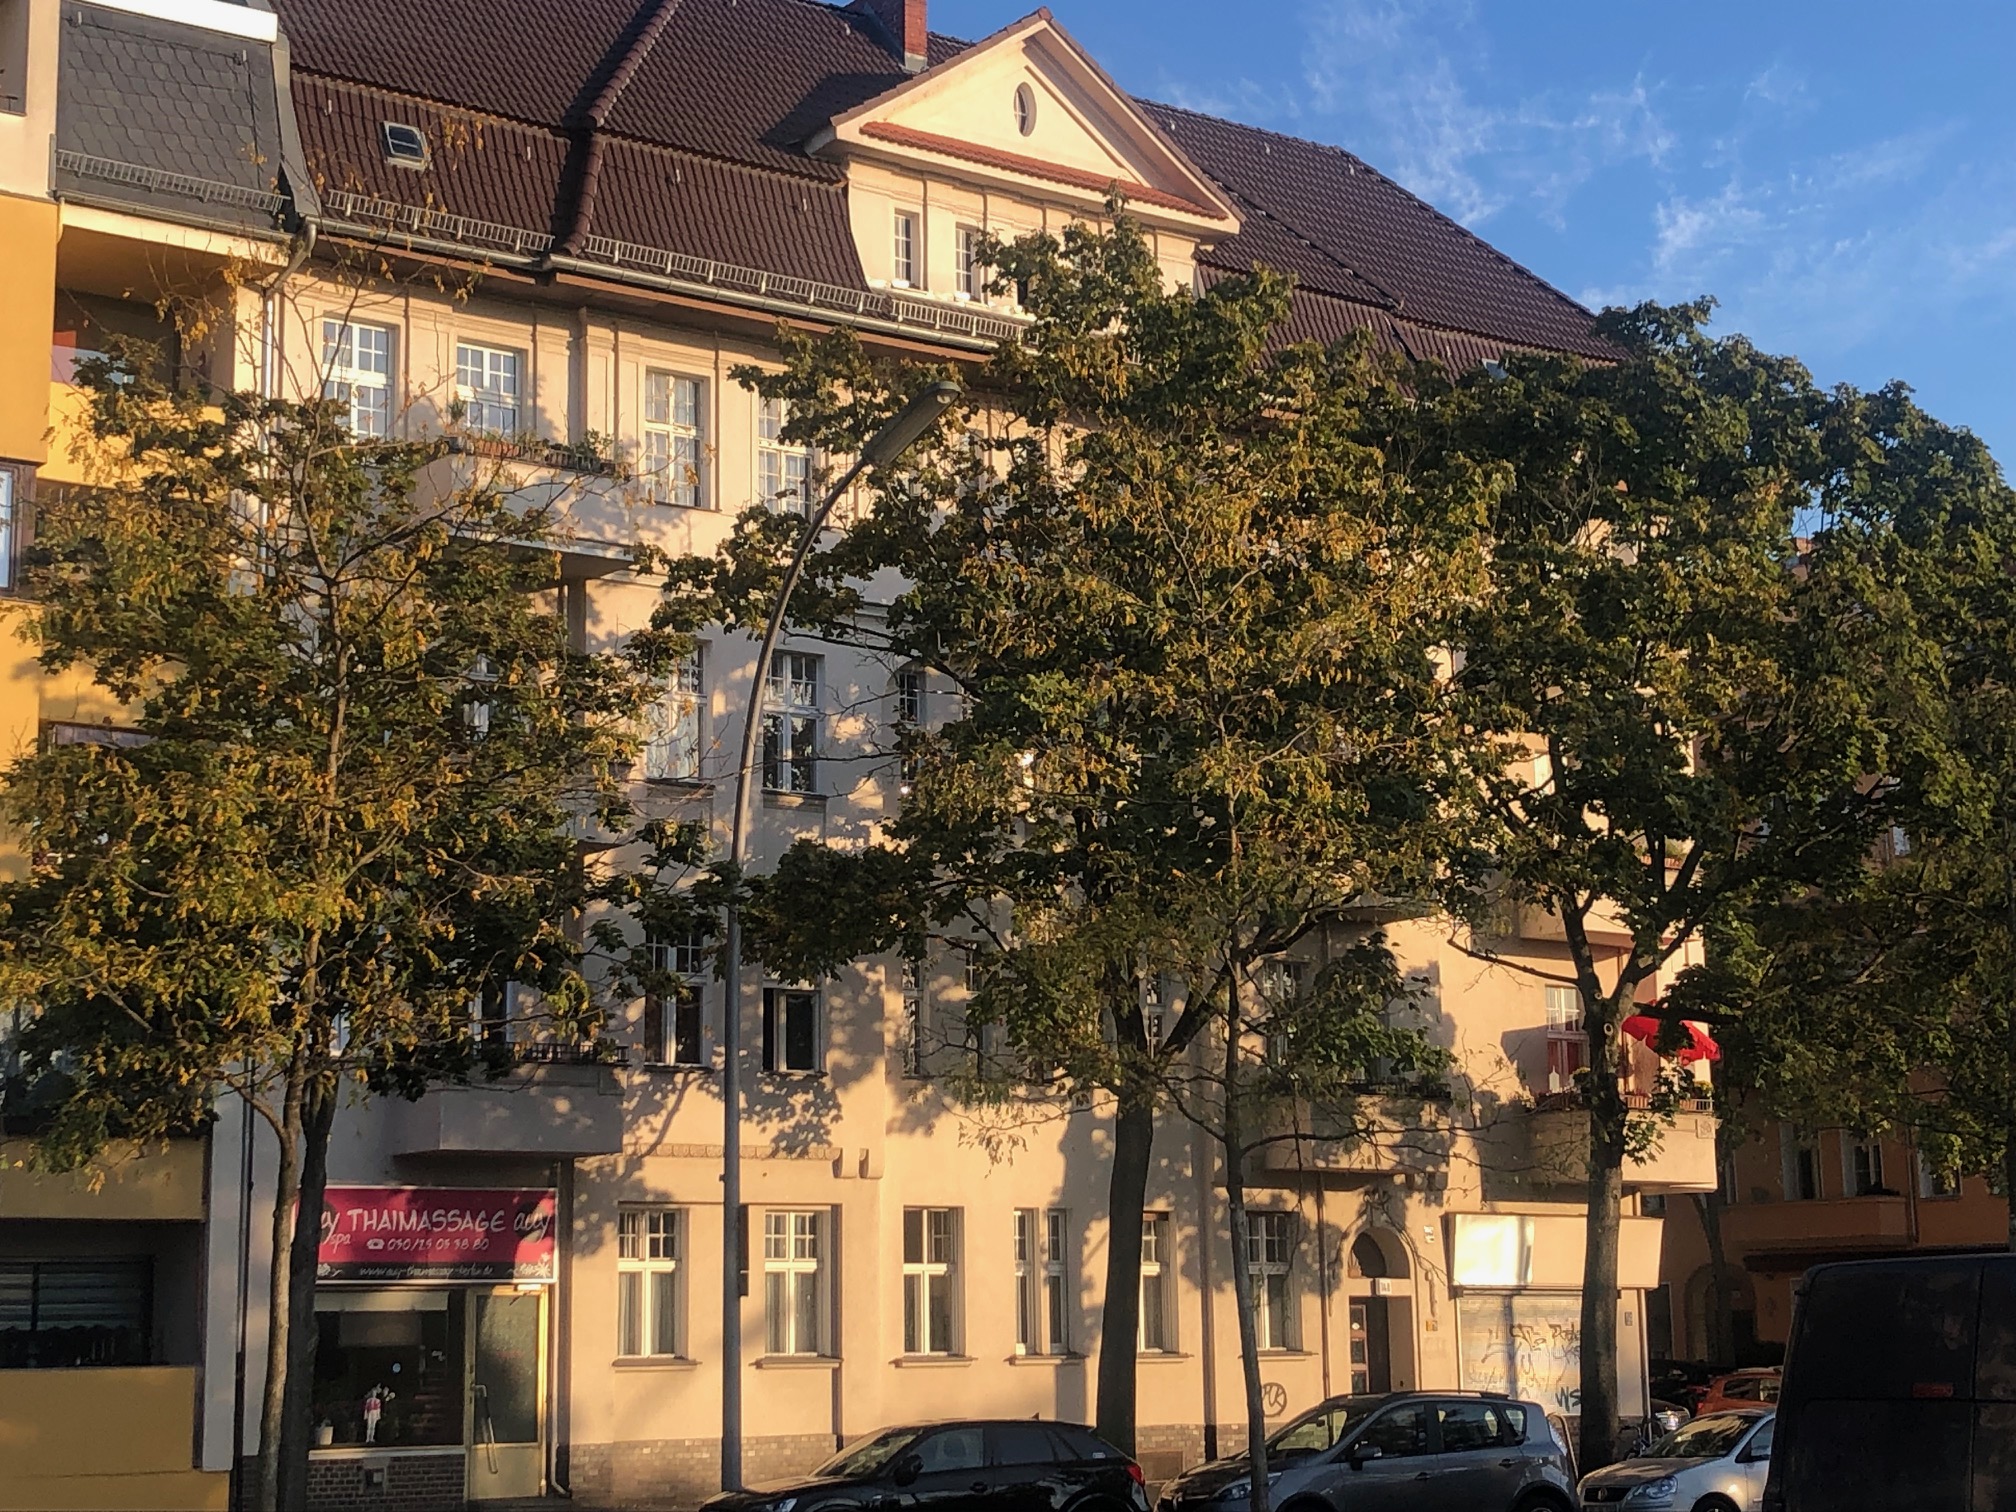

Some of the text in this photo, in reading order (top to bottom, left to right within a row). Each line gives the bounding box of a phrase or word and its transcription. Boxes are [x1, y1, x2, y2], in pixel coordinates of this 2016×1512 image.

[346, 1208, 506, 1233] THAIMASSAGE
[330, 1233, 351, 1254] spa
[472, 1238, 489, 1251] 80
